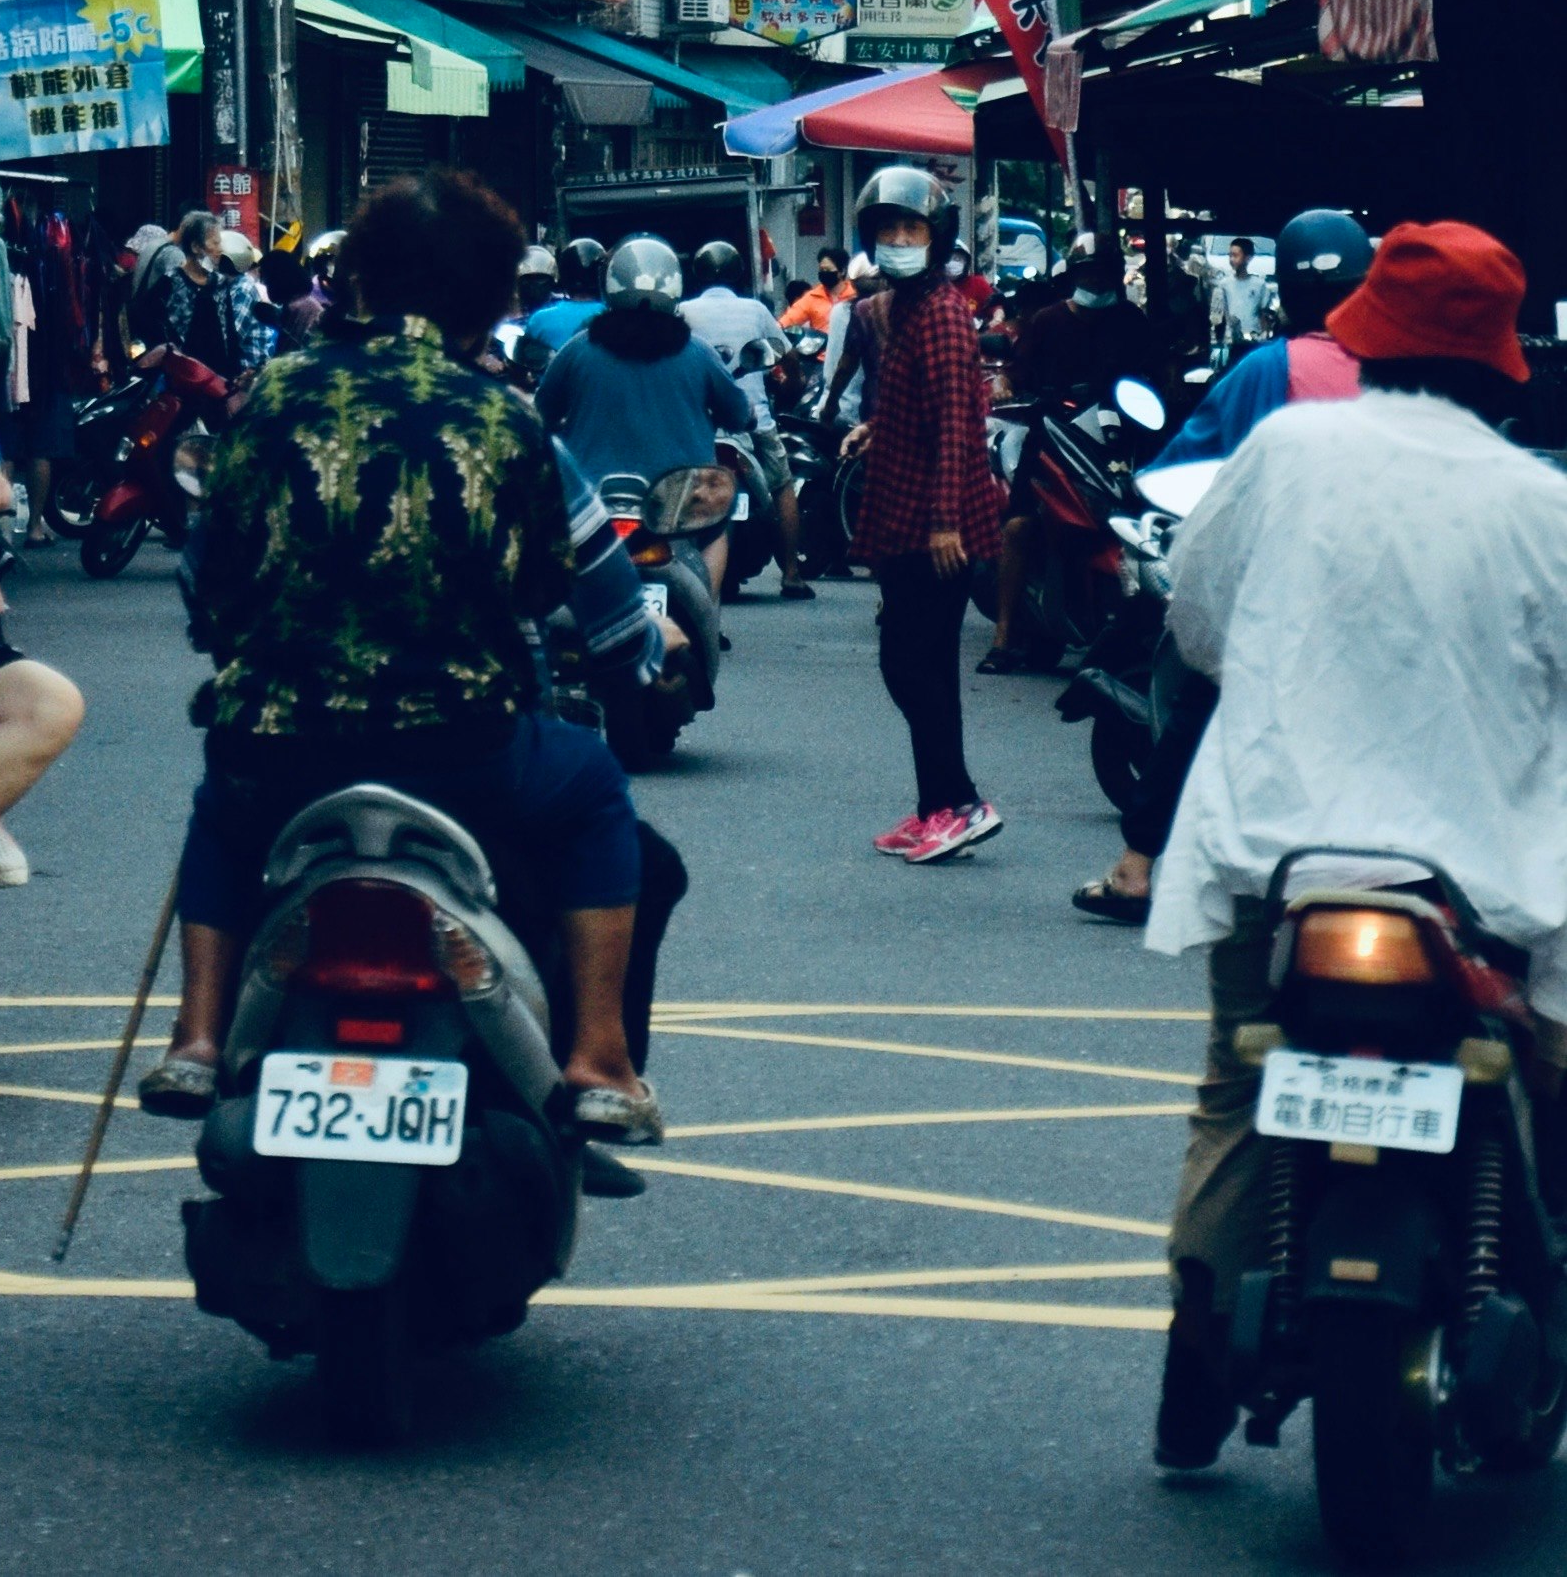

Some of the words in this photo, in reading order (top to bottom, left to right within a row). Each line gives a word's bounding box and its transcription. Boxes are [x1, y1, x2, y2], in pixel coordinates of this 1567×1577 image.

[855, 42, 952, 60] 宏安中藥
[214, 174, 252, 196] 全館
[1275, 1093, 1442, 1141] 電動自行車
